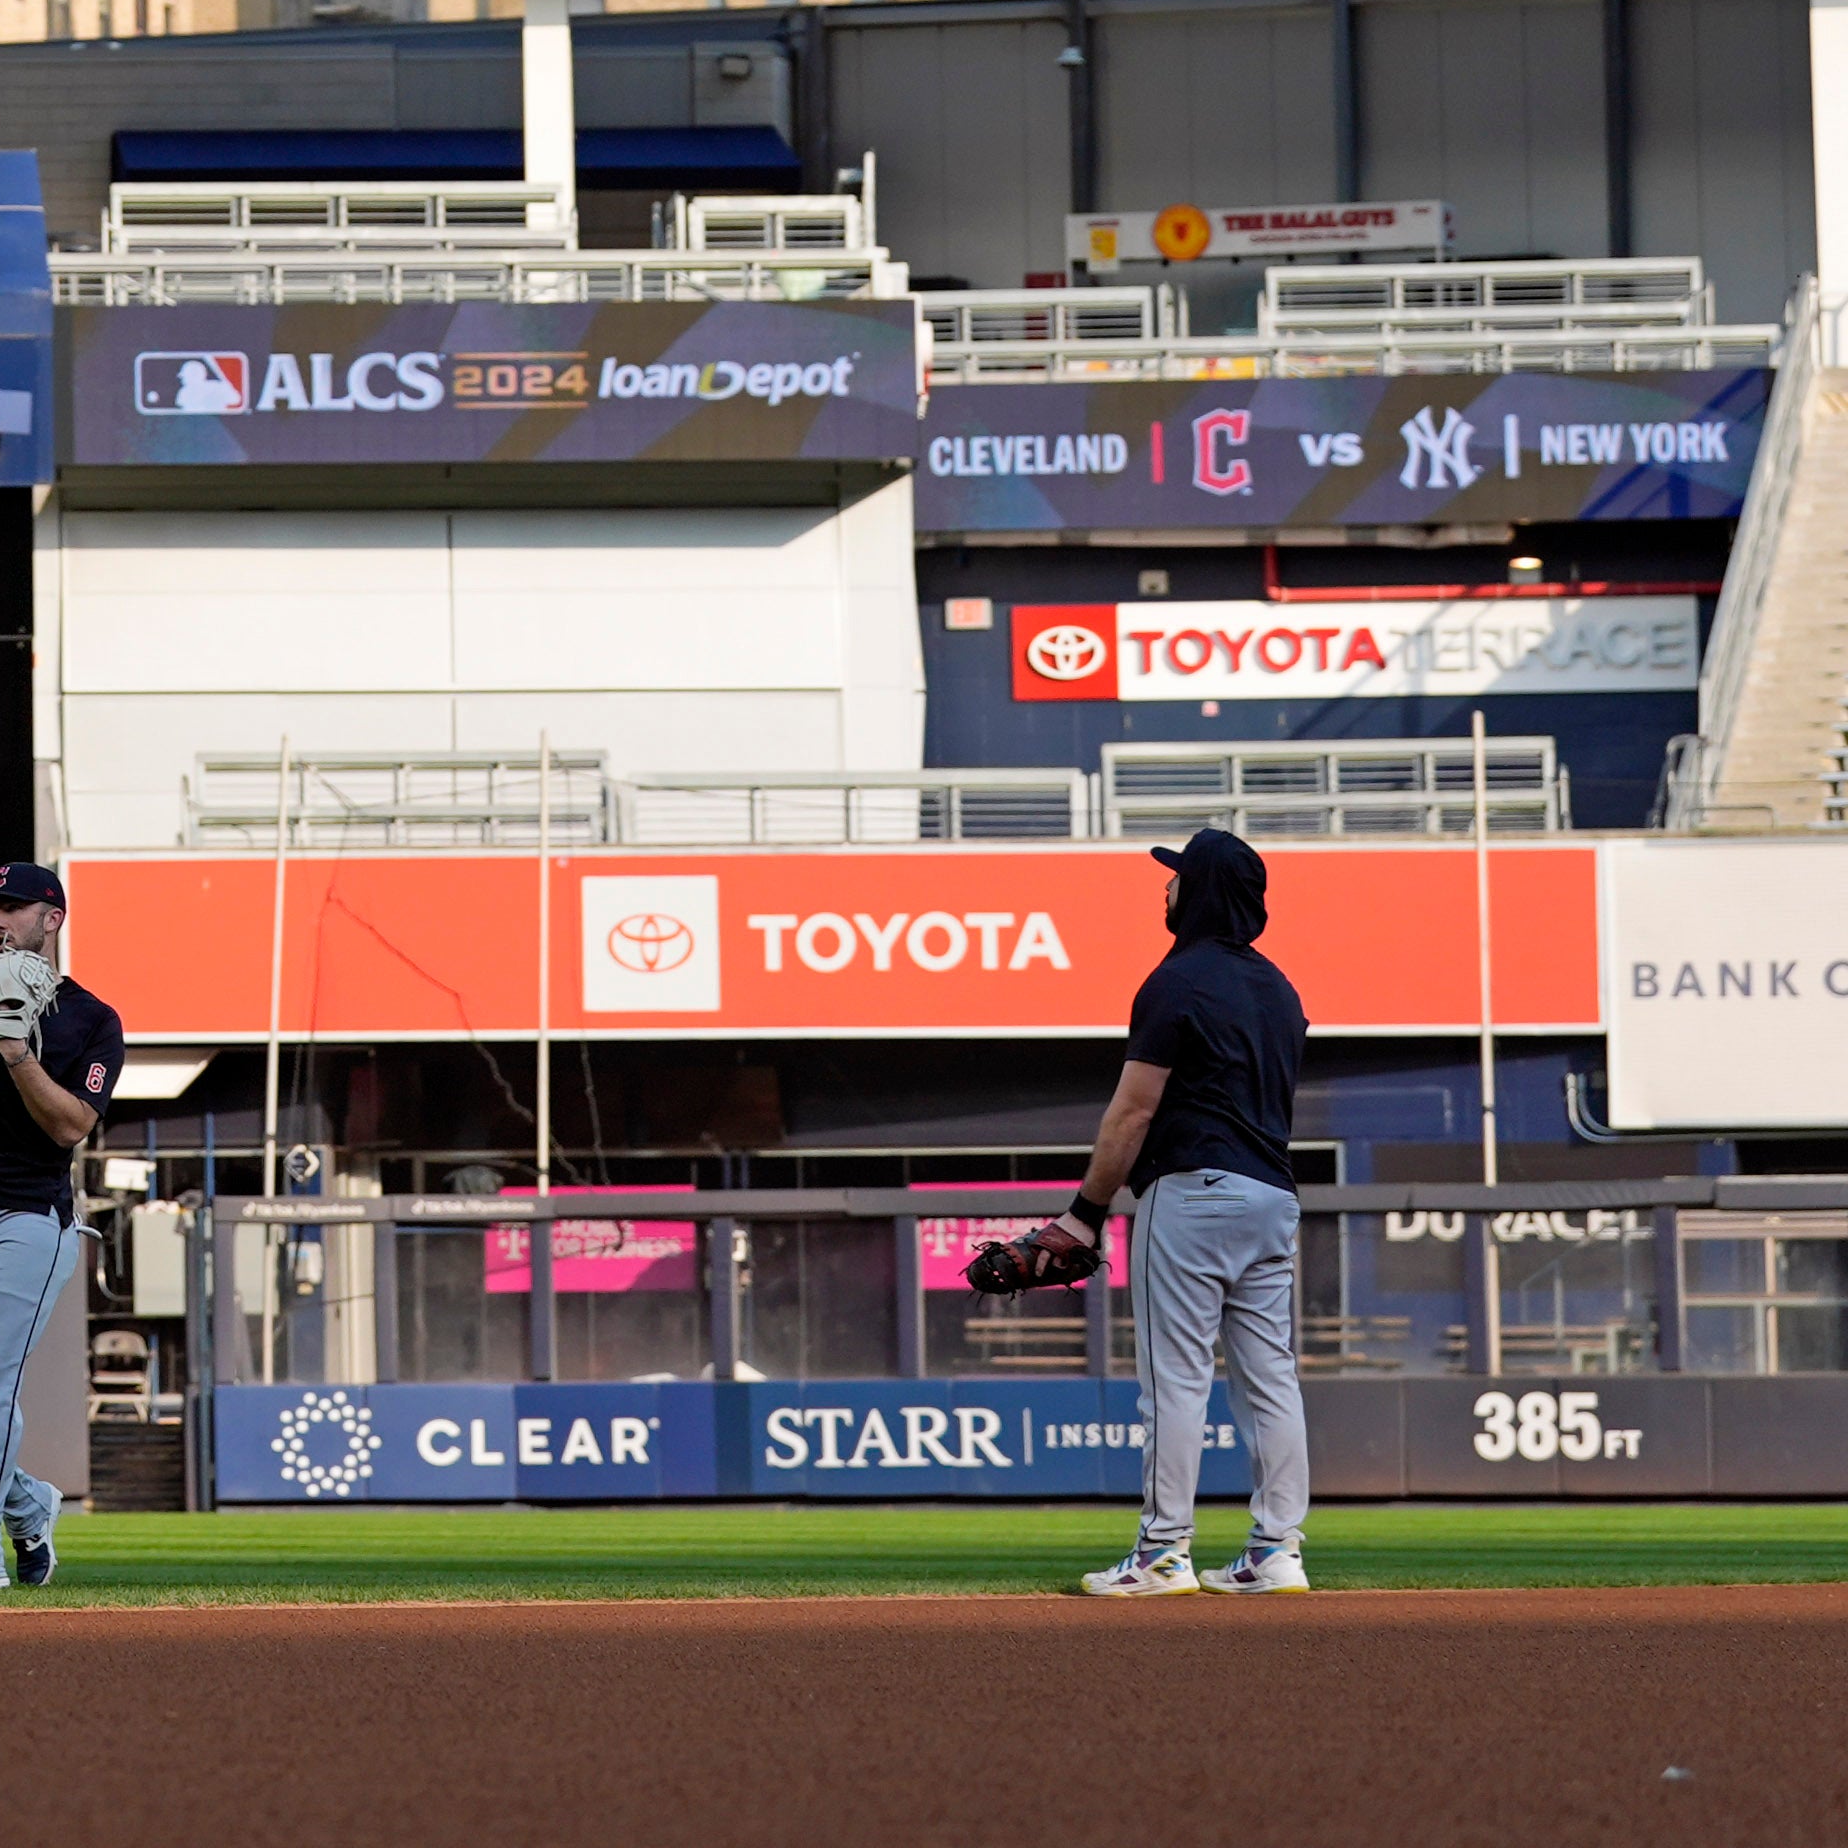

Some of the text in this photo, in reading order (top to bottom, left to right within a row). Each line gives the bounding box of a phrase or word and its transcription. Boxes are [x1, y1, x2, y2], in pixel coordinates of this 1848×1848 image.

[256, 352, 853, 411] ALCS 2024 loanDepot
[928, 433, 1128, 476] CLEVELAND
[1540, 425, 1627, 466] NEW
[1630, 422, 1729, 465] YORK
[1127, 618, 1694, 676] TOYOTA TERRACE
[748, 908, 1073, 973] TOYOTA
[1632, 960, 1799, 999] BANK
[417, 1417, 651, 1466] CLEAR
[765, 1405, 1236, 1470] STARR INSURCE
